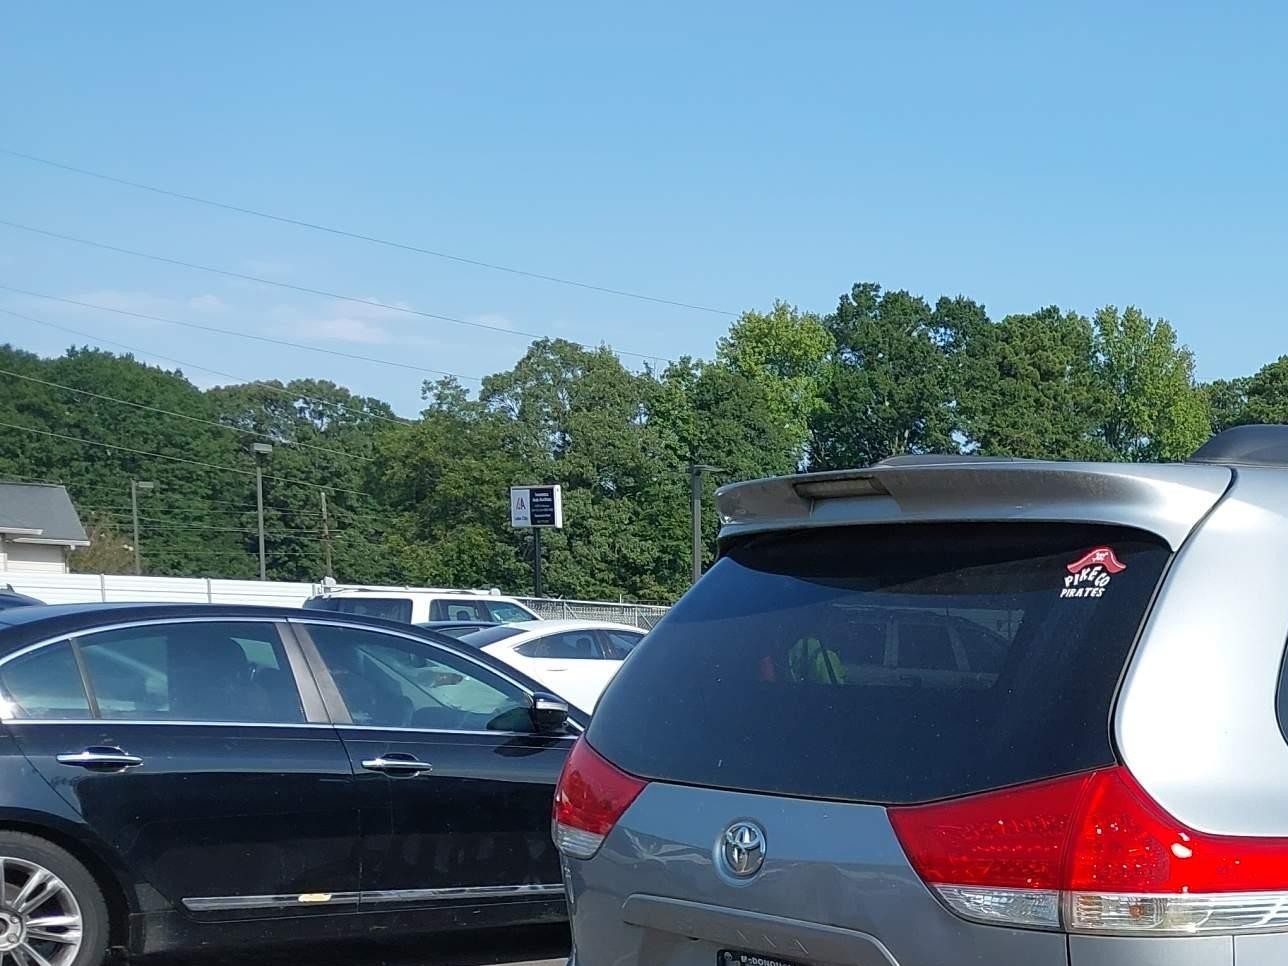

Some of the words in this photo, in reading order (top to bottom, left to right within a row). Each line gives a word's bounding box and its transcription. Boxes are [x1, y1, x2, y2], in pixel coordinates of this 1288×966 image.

[1064, 566, 1102, 587] PIKE
[1094, 572, 1111, 587] CO
[1060, 587, 1106, 598] PIRATES
